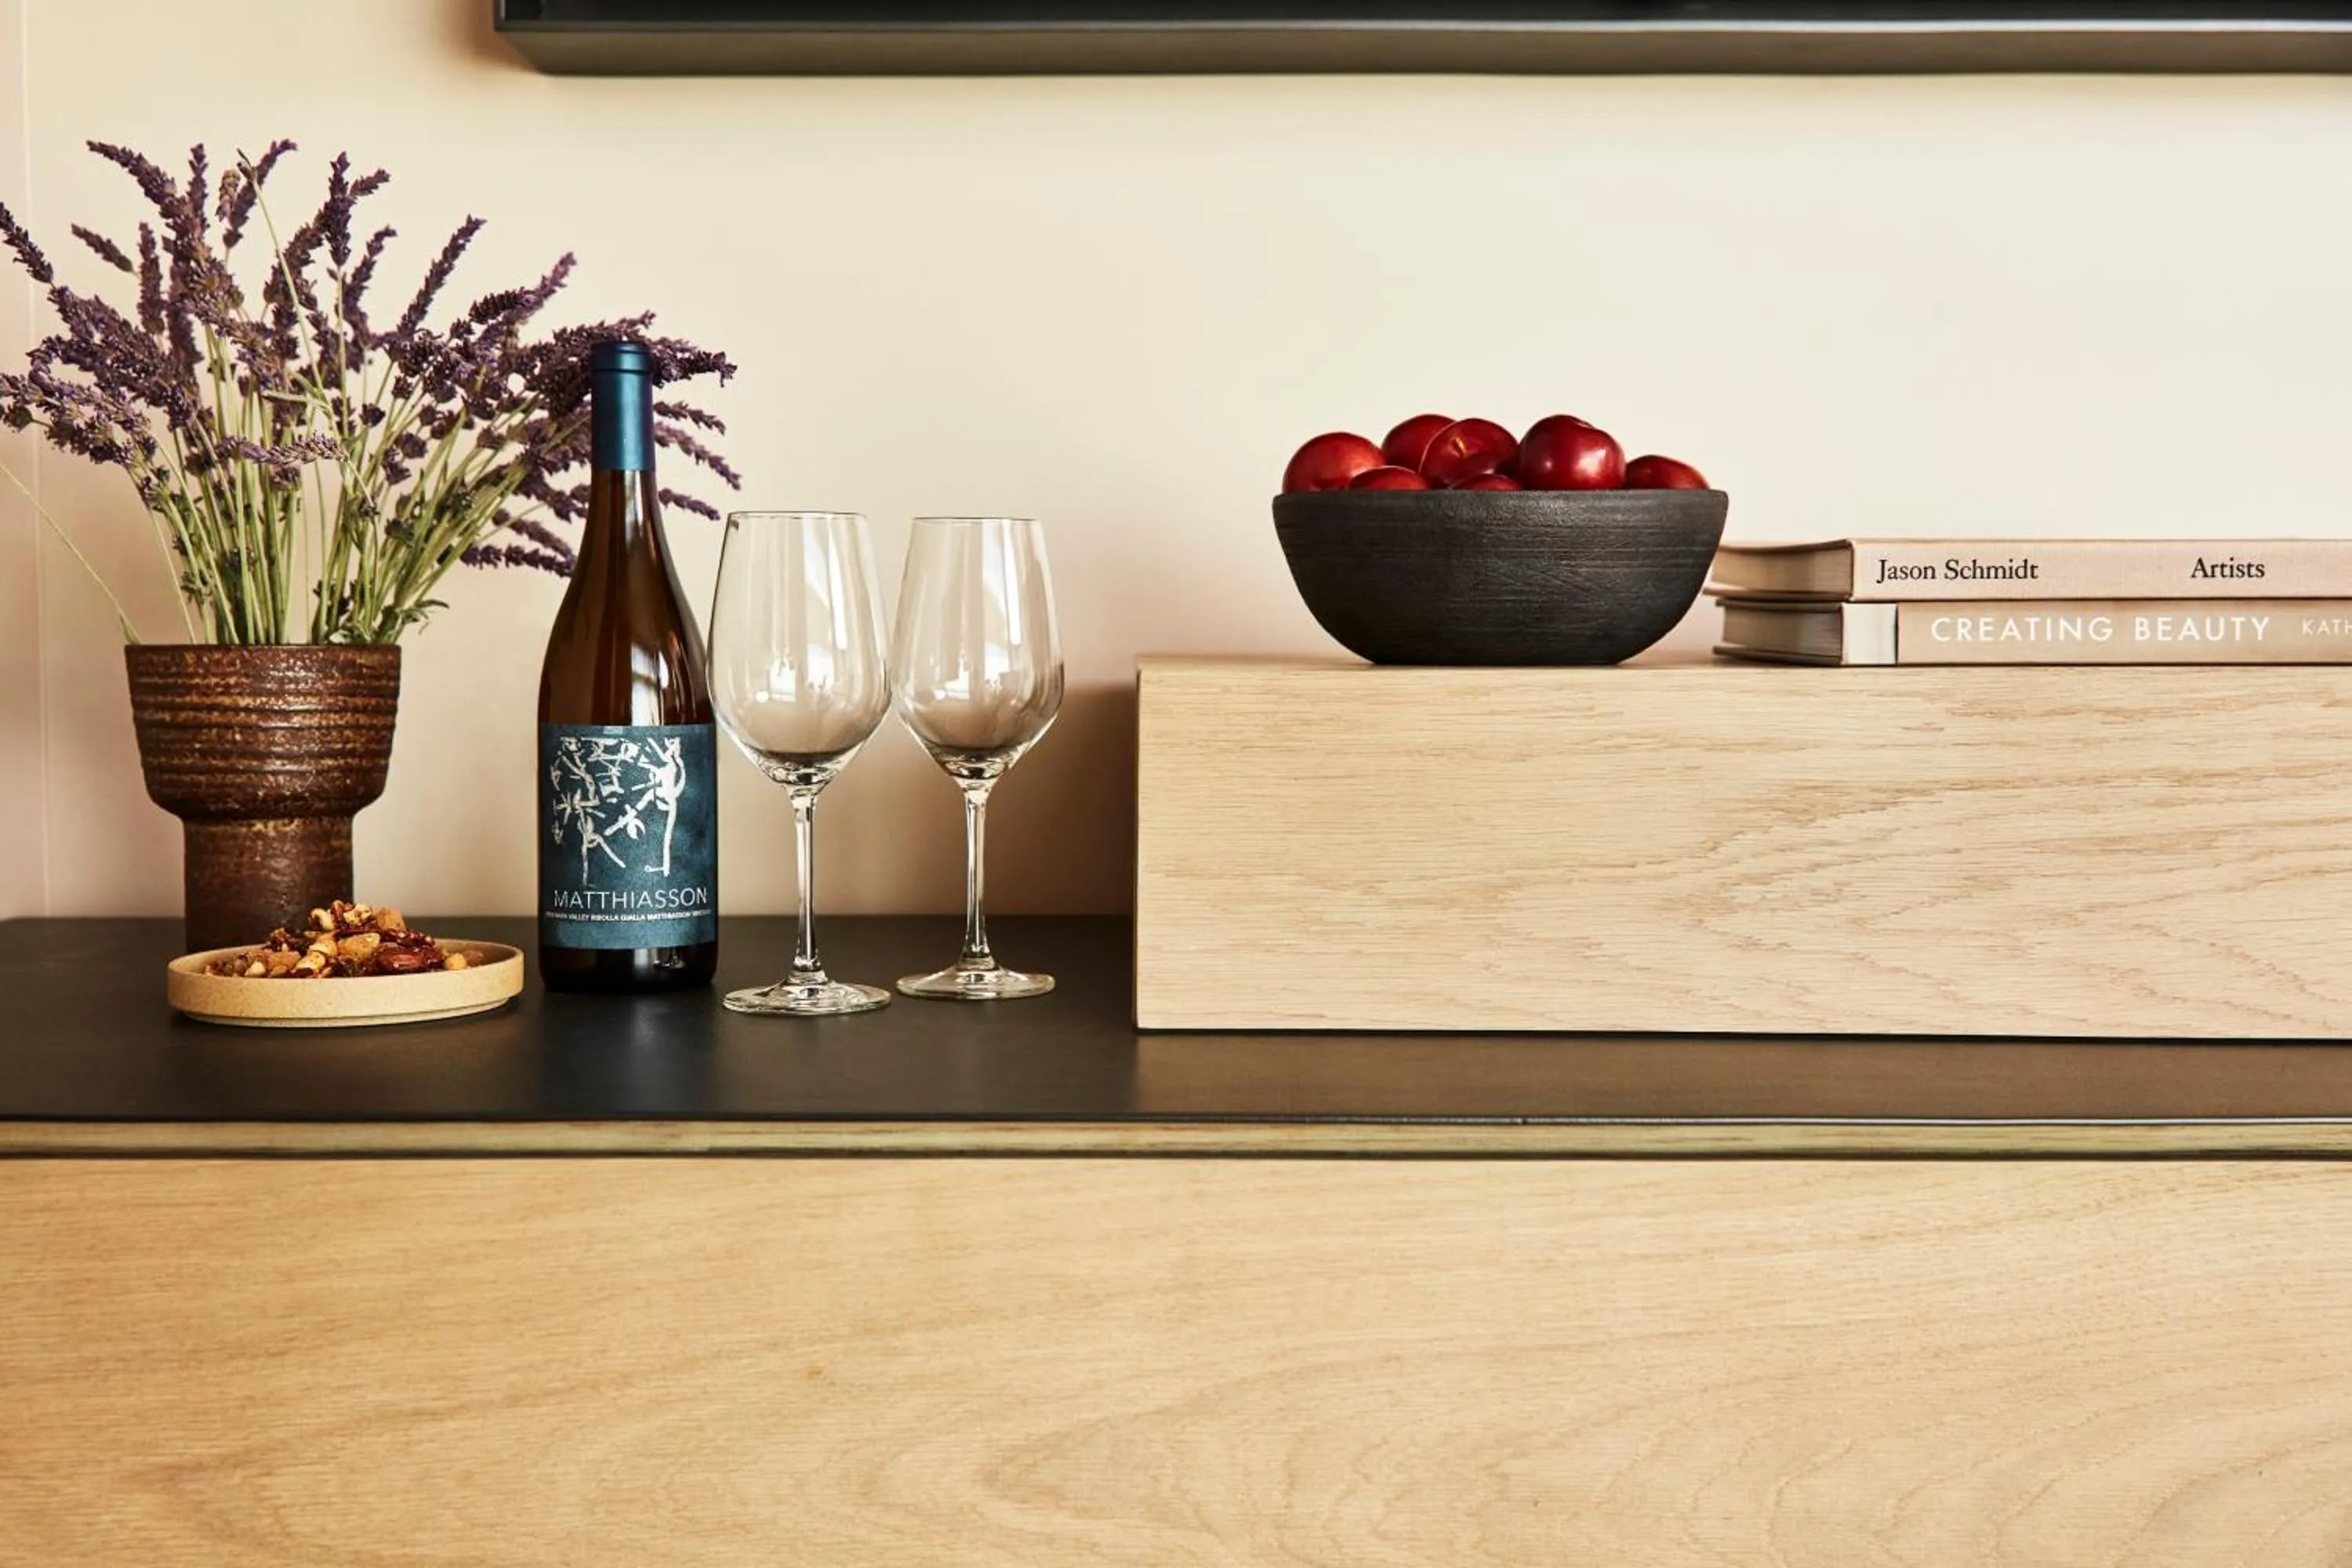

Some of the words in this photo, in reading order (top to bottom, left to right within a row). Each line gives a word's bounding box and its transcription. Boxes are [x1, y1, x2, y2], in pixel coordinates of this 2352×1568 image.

[1876, 558, 1936, 583] Jason
[1944, 558, 2038, 580] Schmidt
[2190, 557, 2265, 578] Artists
[1931, 617, 2111, 641] CREATING
[2135, 616, 2270, 641] BEAUTY
[554, 887, 707, 909] MATTHIASSON
